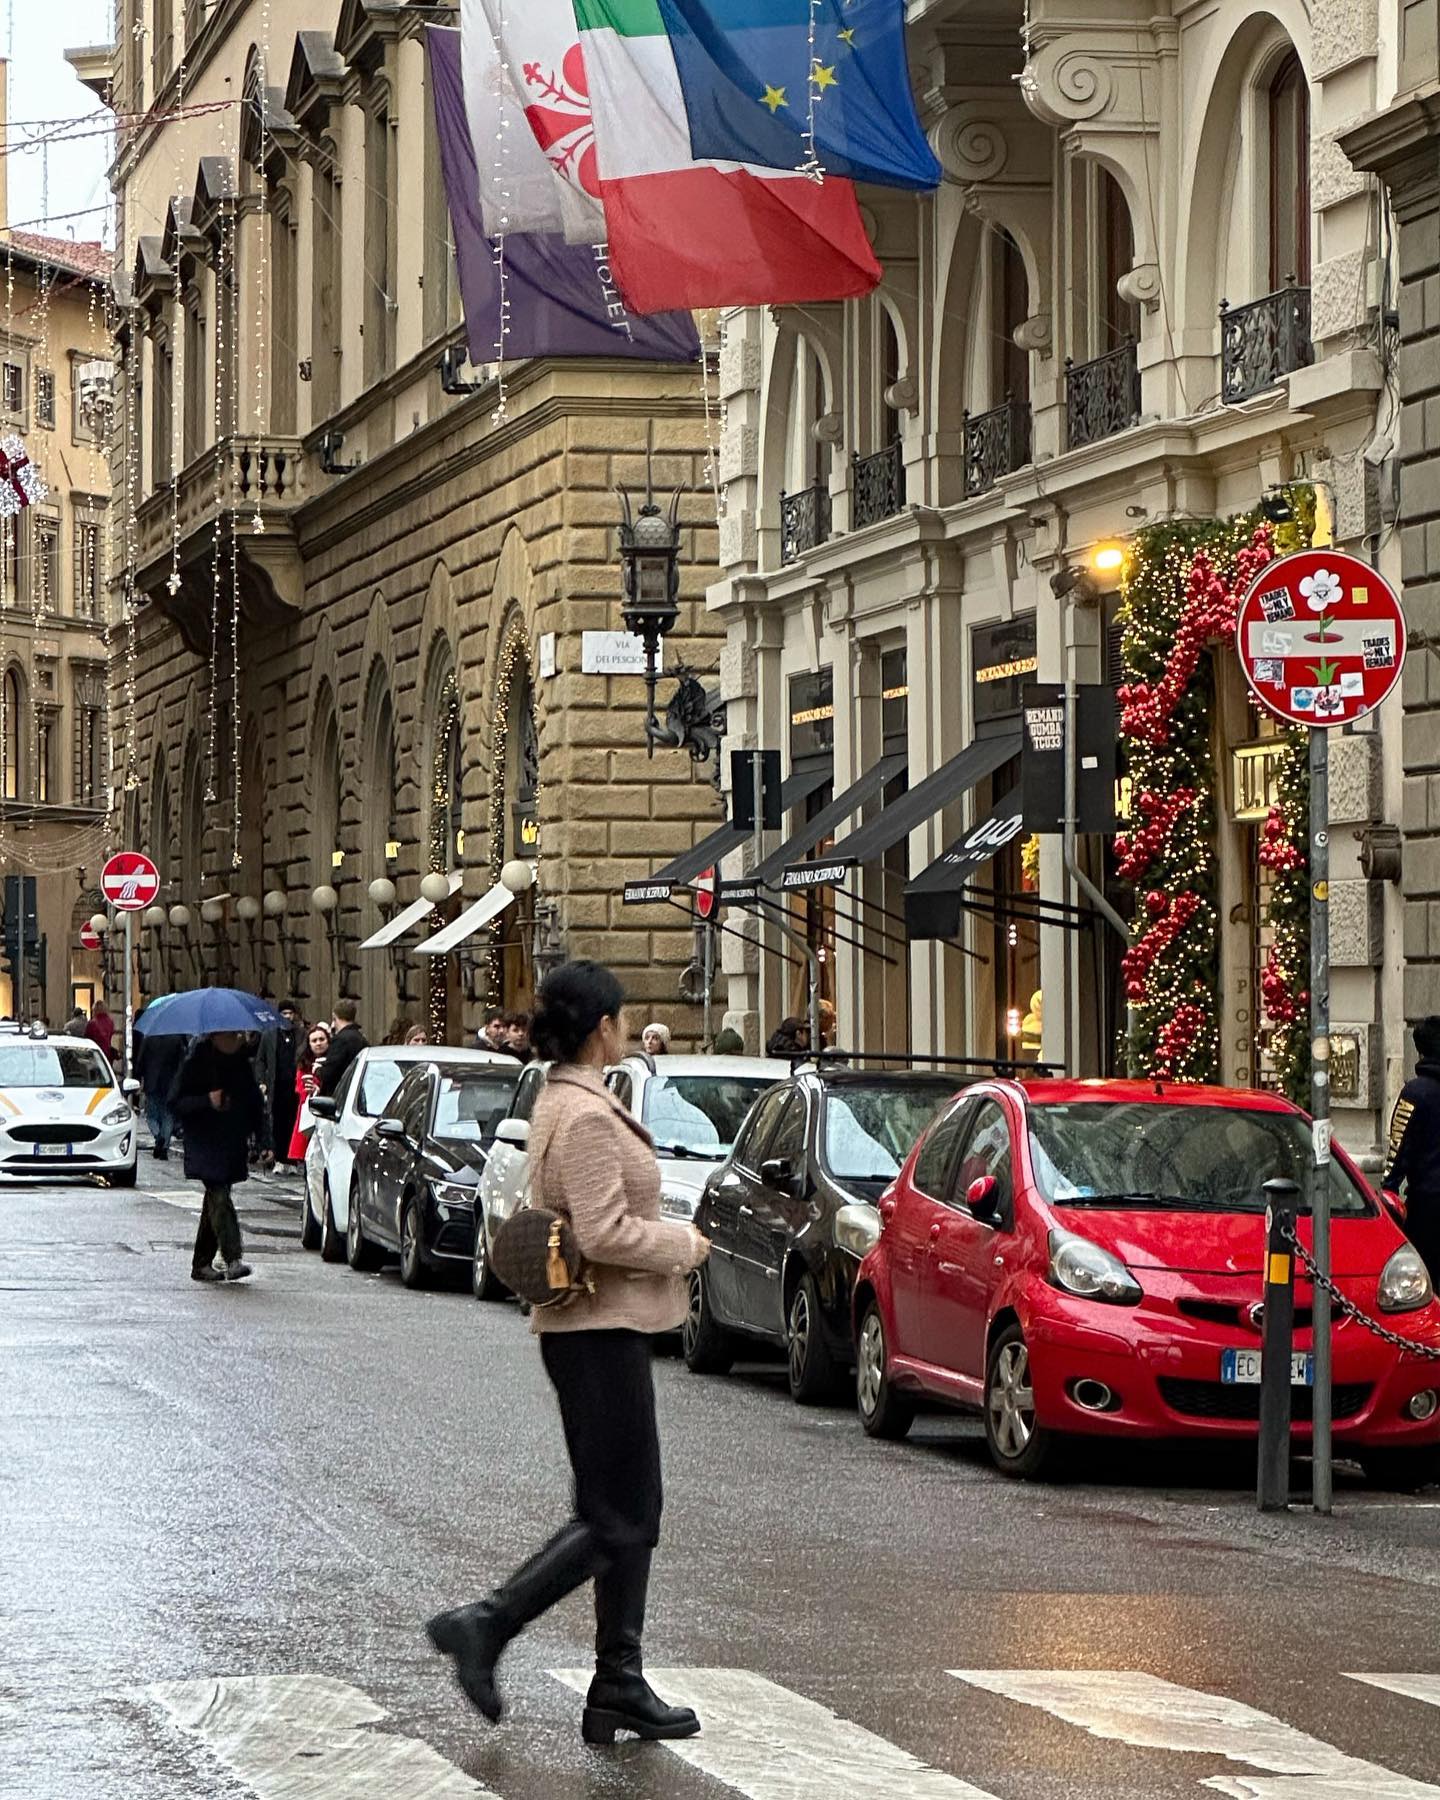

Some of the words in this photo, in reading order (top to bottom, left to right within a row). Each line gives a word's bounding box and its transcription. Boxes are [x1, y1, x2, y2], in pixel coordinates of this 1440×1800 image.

[1260, 588, 1288, 604] TRADES
[615, 641, 631, 649] VIA
[1362, 637, 1390, 648] TRADES
[595, 655, 612, 664] DEI
[1026, 709, 1064, 723] REMAND
[1234, 979, 1249, 1081] POGG
